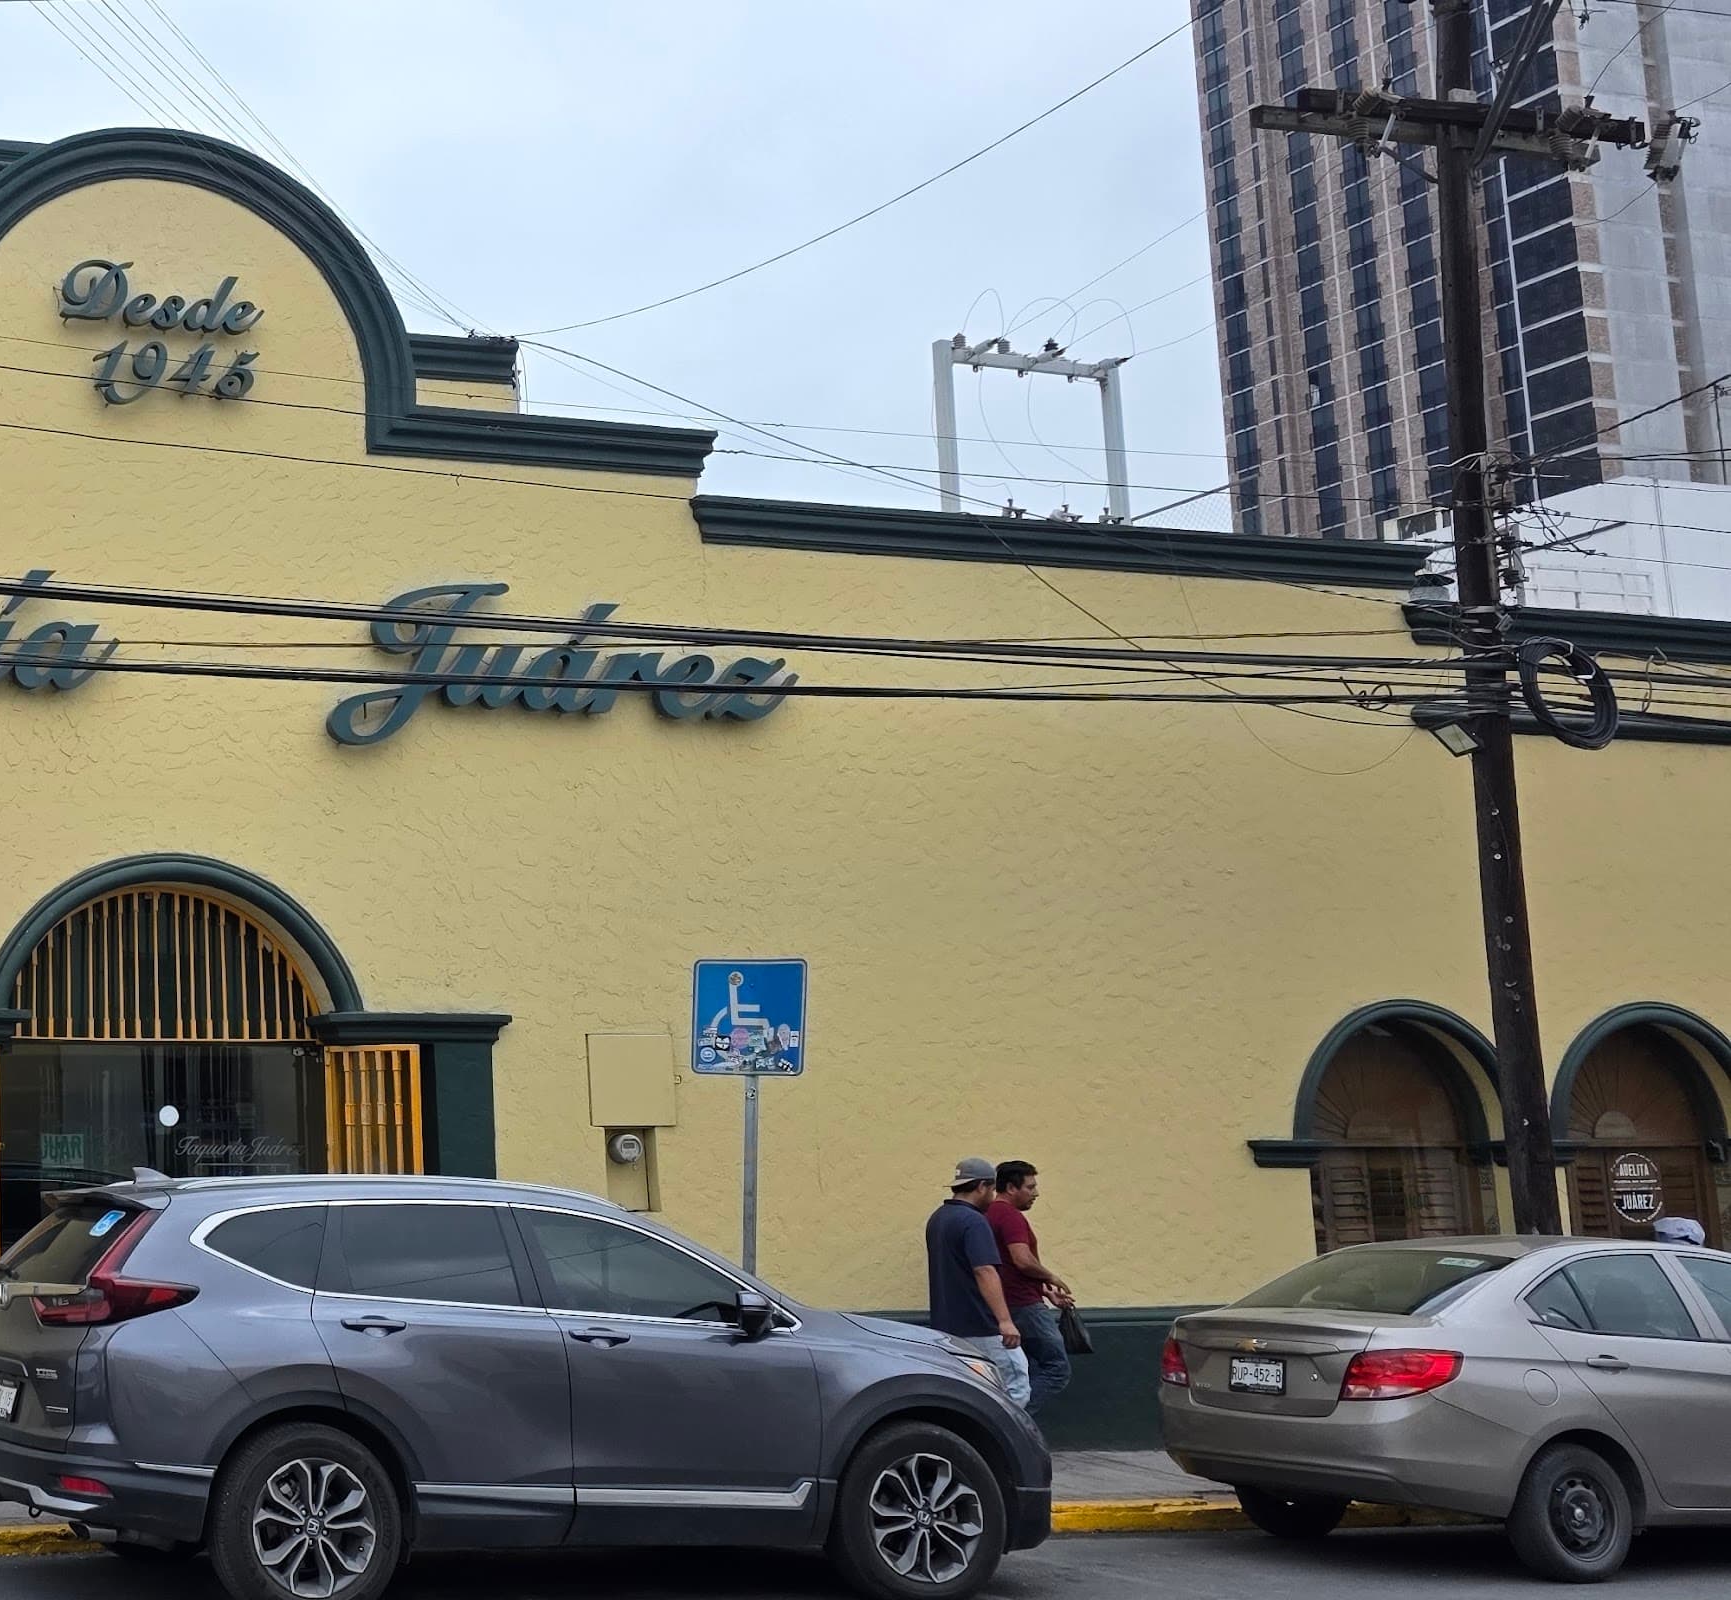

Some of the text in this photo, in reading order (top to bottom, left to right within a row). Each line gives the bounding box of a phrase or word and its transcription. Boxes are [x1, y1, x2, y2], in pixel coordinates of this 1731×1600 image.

[59, 259, 265, 335] Desde
[92, 340, 260, 405] 1945
[326, 582, 800, 745] Juárez
[174, 1135, 248, 1163] Taquería
[1621, 1191, 1655, 1210] JUÁREZ
